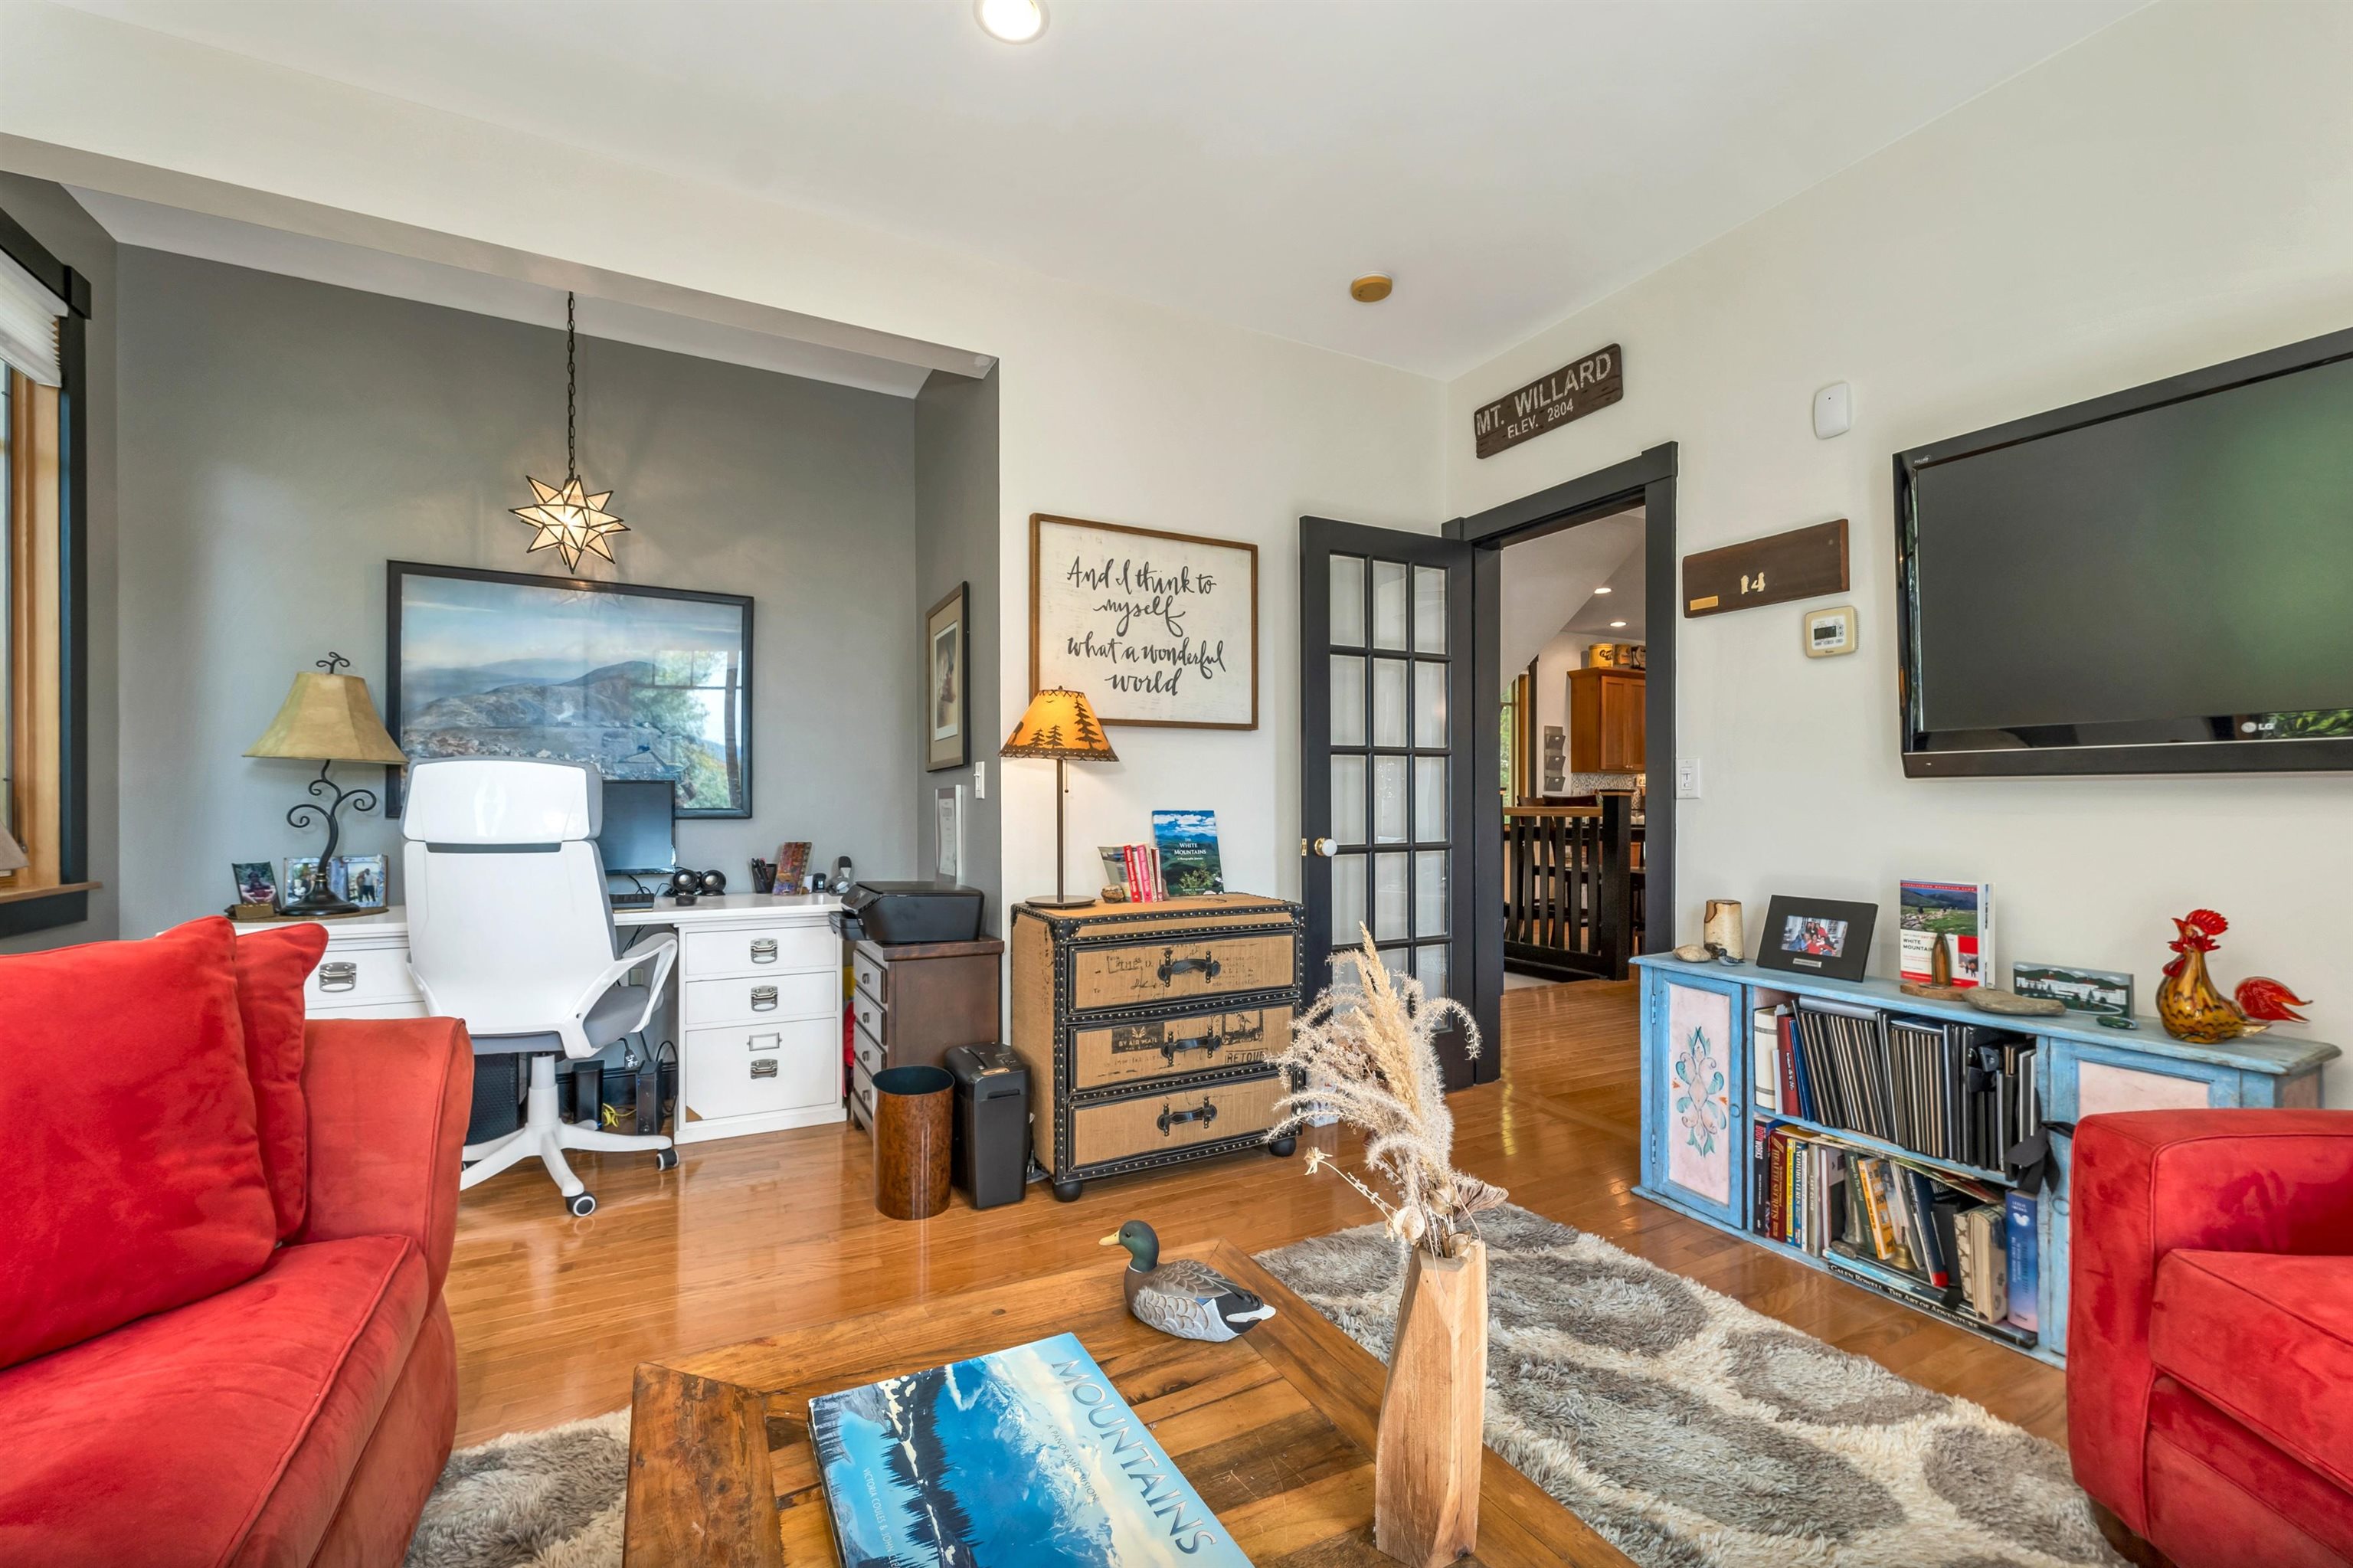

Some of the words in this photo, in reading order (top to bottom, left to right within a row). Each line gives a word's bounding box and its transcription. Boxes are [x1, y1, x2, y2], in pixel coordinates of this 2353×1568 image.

[1476, 404, 1504, 436] MT.
[1514, 352, 1612, 417] WILLARD
[1507, 414, 1538, 439] ELEV.
[1547, 398, 1574, 421] 2804
[1067, 555, 1114, 591] And
[1115, 558, 1132, 595] I
[1135, 561, 1195, 596] think
[1196, 573, 1217, 594] to
[1740, 571, 1766, 595] 14
[1092, 594, 1186, 637] myself
[1067, 630, 1123, 664] what
[1121, 646, 1140, 663] a
[1141, 637, 1226, 680] wonderful
[1104, 667, 1183, 696] world
[1771, 1148, 1780, 1182] HEALTH
[1771, 1183, 1779, 1220] SECRETS
[1830, 1265, 1854, 1279] GALEN
[1854, 1274, 1883, 1290] ROWELL
[1887, 1287, 1903, 1298] THE
[1903, 1295, 1919, 1305] ART
[1930, 1304, 1979, 1329] ADVENTURE
[1051, 1359, 1216, 1555] MOUNTAINS
[1051, 1430, 1082, 1474] PANORAMIC
[1078, 1471, 1100, 1502] VISION
[863, 1467, 878, 1498] VICTORIA
[872, 1498, 886, 1524] COULES
[882, 1533, 895, 1553] JOHN
